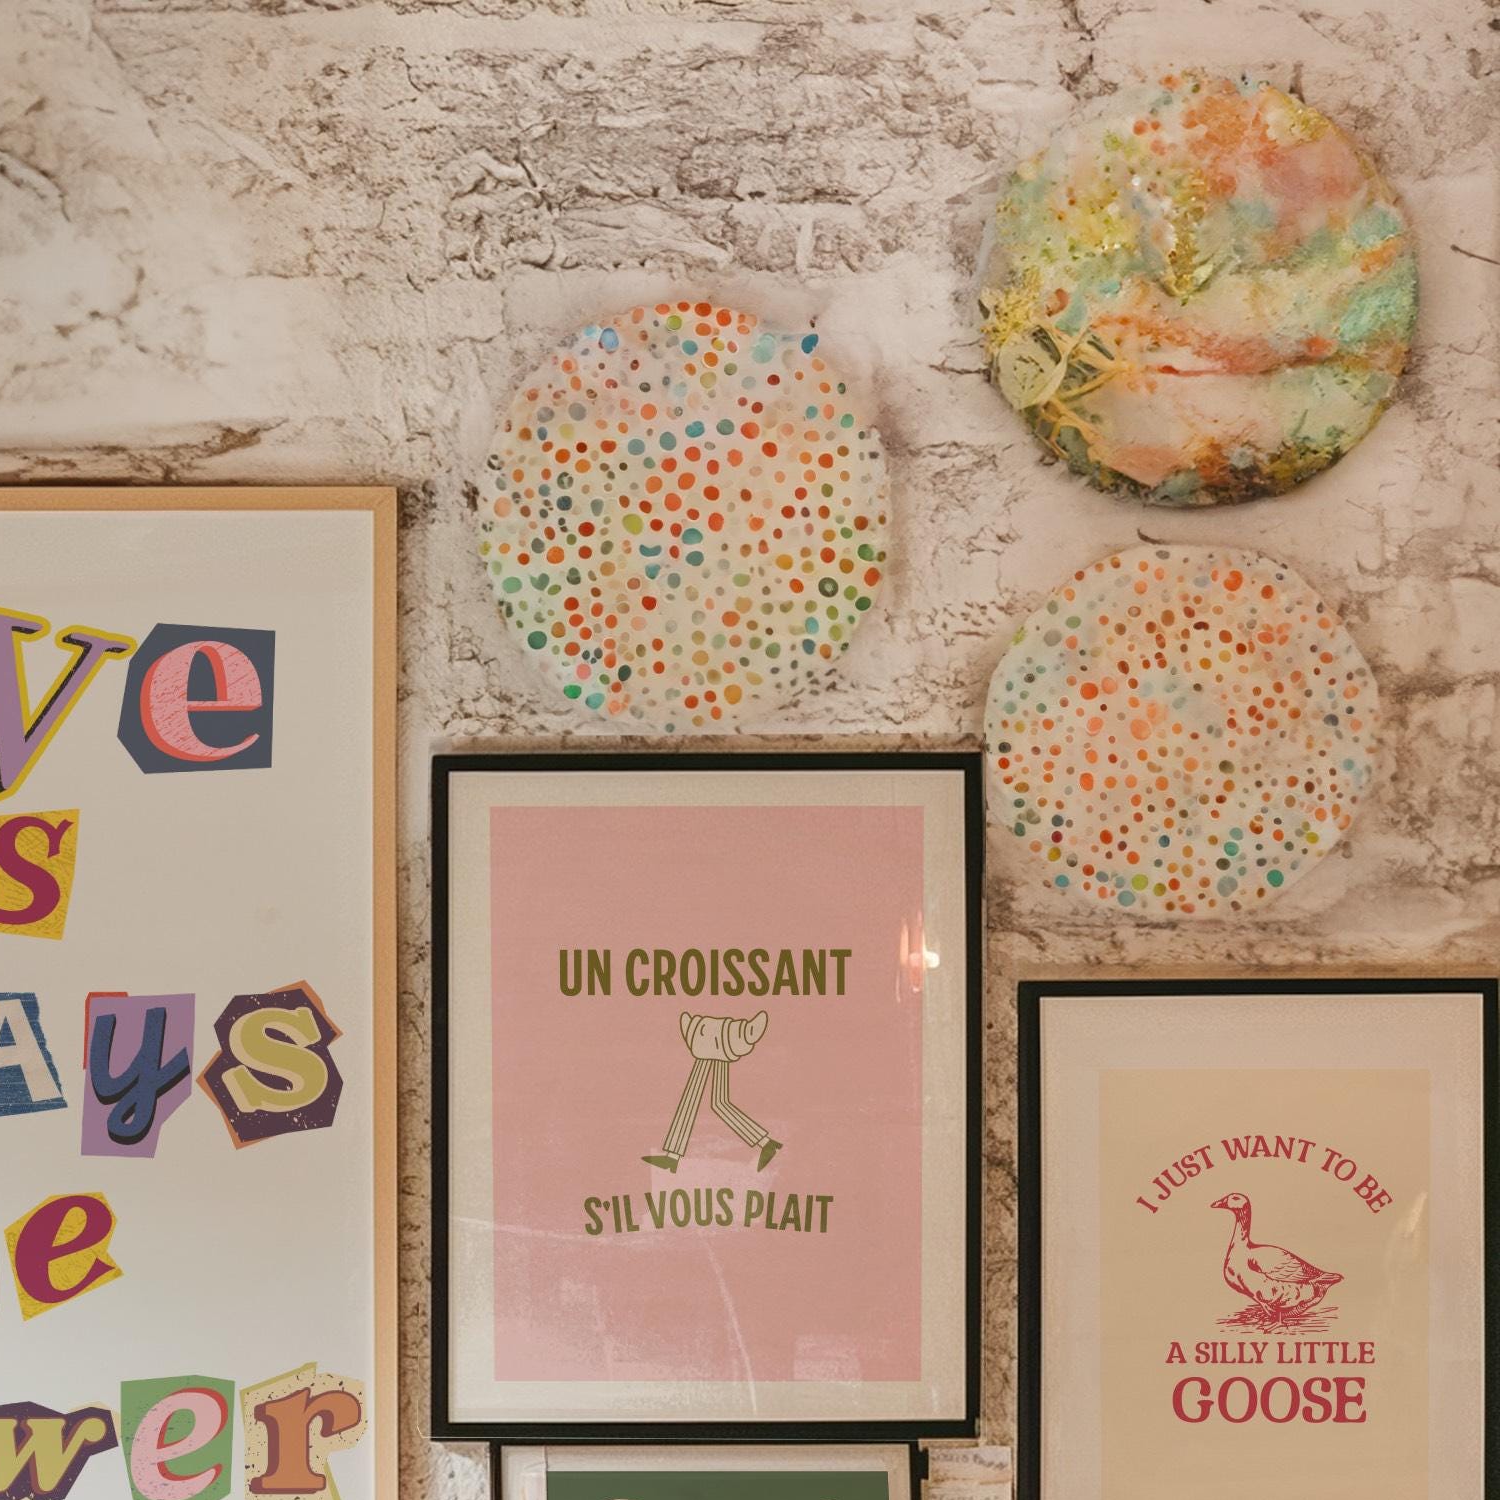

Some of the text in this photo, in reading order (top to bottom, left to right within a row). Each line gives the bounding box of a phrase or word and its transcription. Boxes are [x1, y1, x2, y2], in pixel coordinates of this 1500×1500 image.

[559, 948, 853, 997] UN CROISSANT
[1136, 1135, 1393, 1214] I JUST WANT TO BE
[583, 1187, 834, 1236] S'IL VOUS PLAIT
[1166, 1341, 1375, 1365] A SILLY LITTLE
[1172, 1375, 1368, 1424] GOOSE
